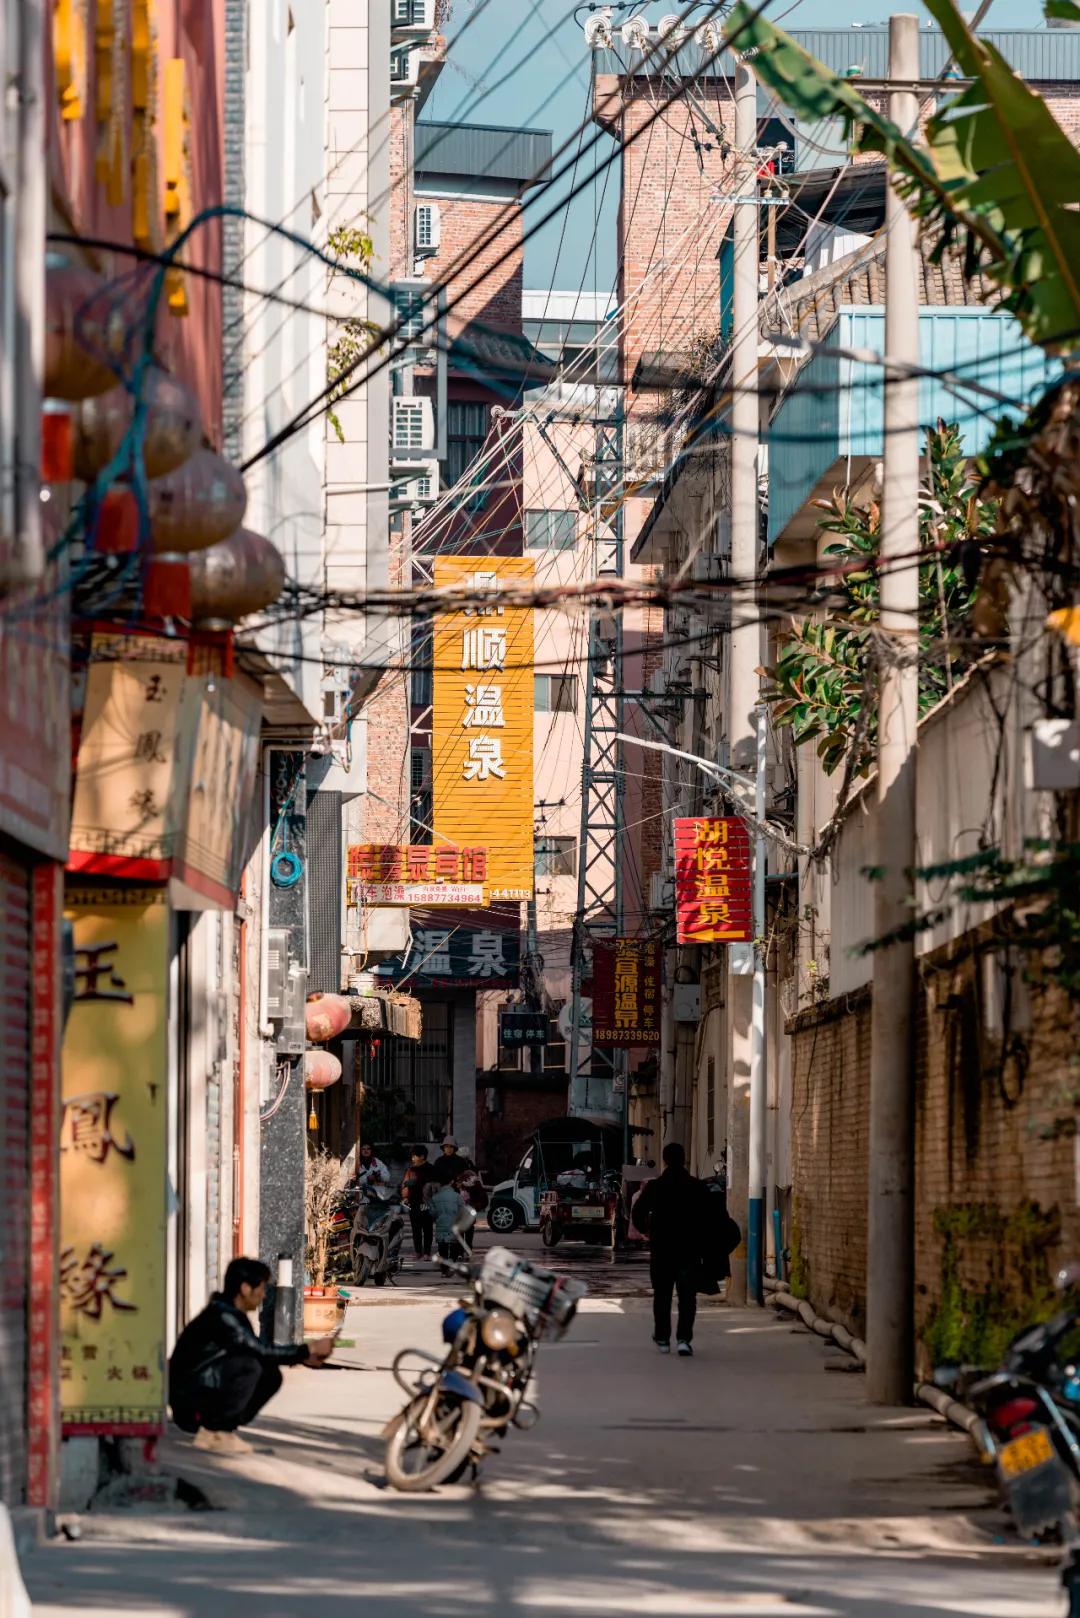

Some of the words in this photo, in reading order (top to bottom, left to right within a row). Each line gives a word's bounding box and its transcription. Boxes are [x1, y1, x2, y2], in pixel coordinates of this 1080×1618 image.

[693, 820, 731, 926] 湖悦温泉
[408, 893, 481, 902] 15887734964
[595, 1028, 660, 1041] 18987339620
